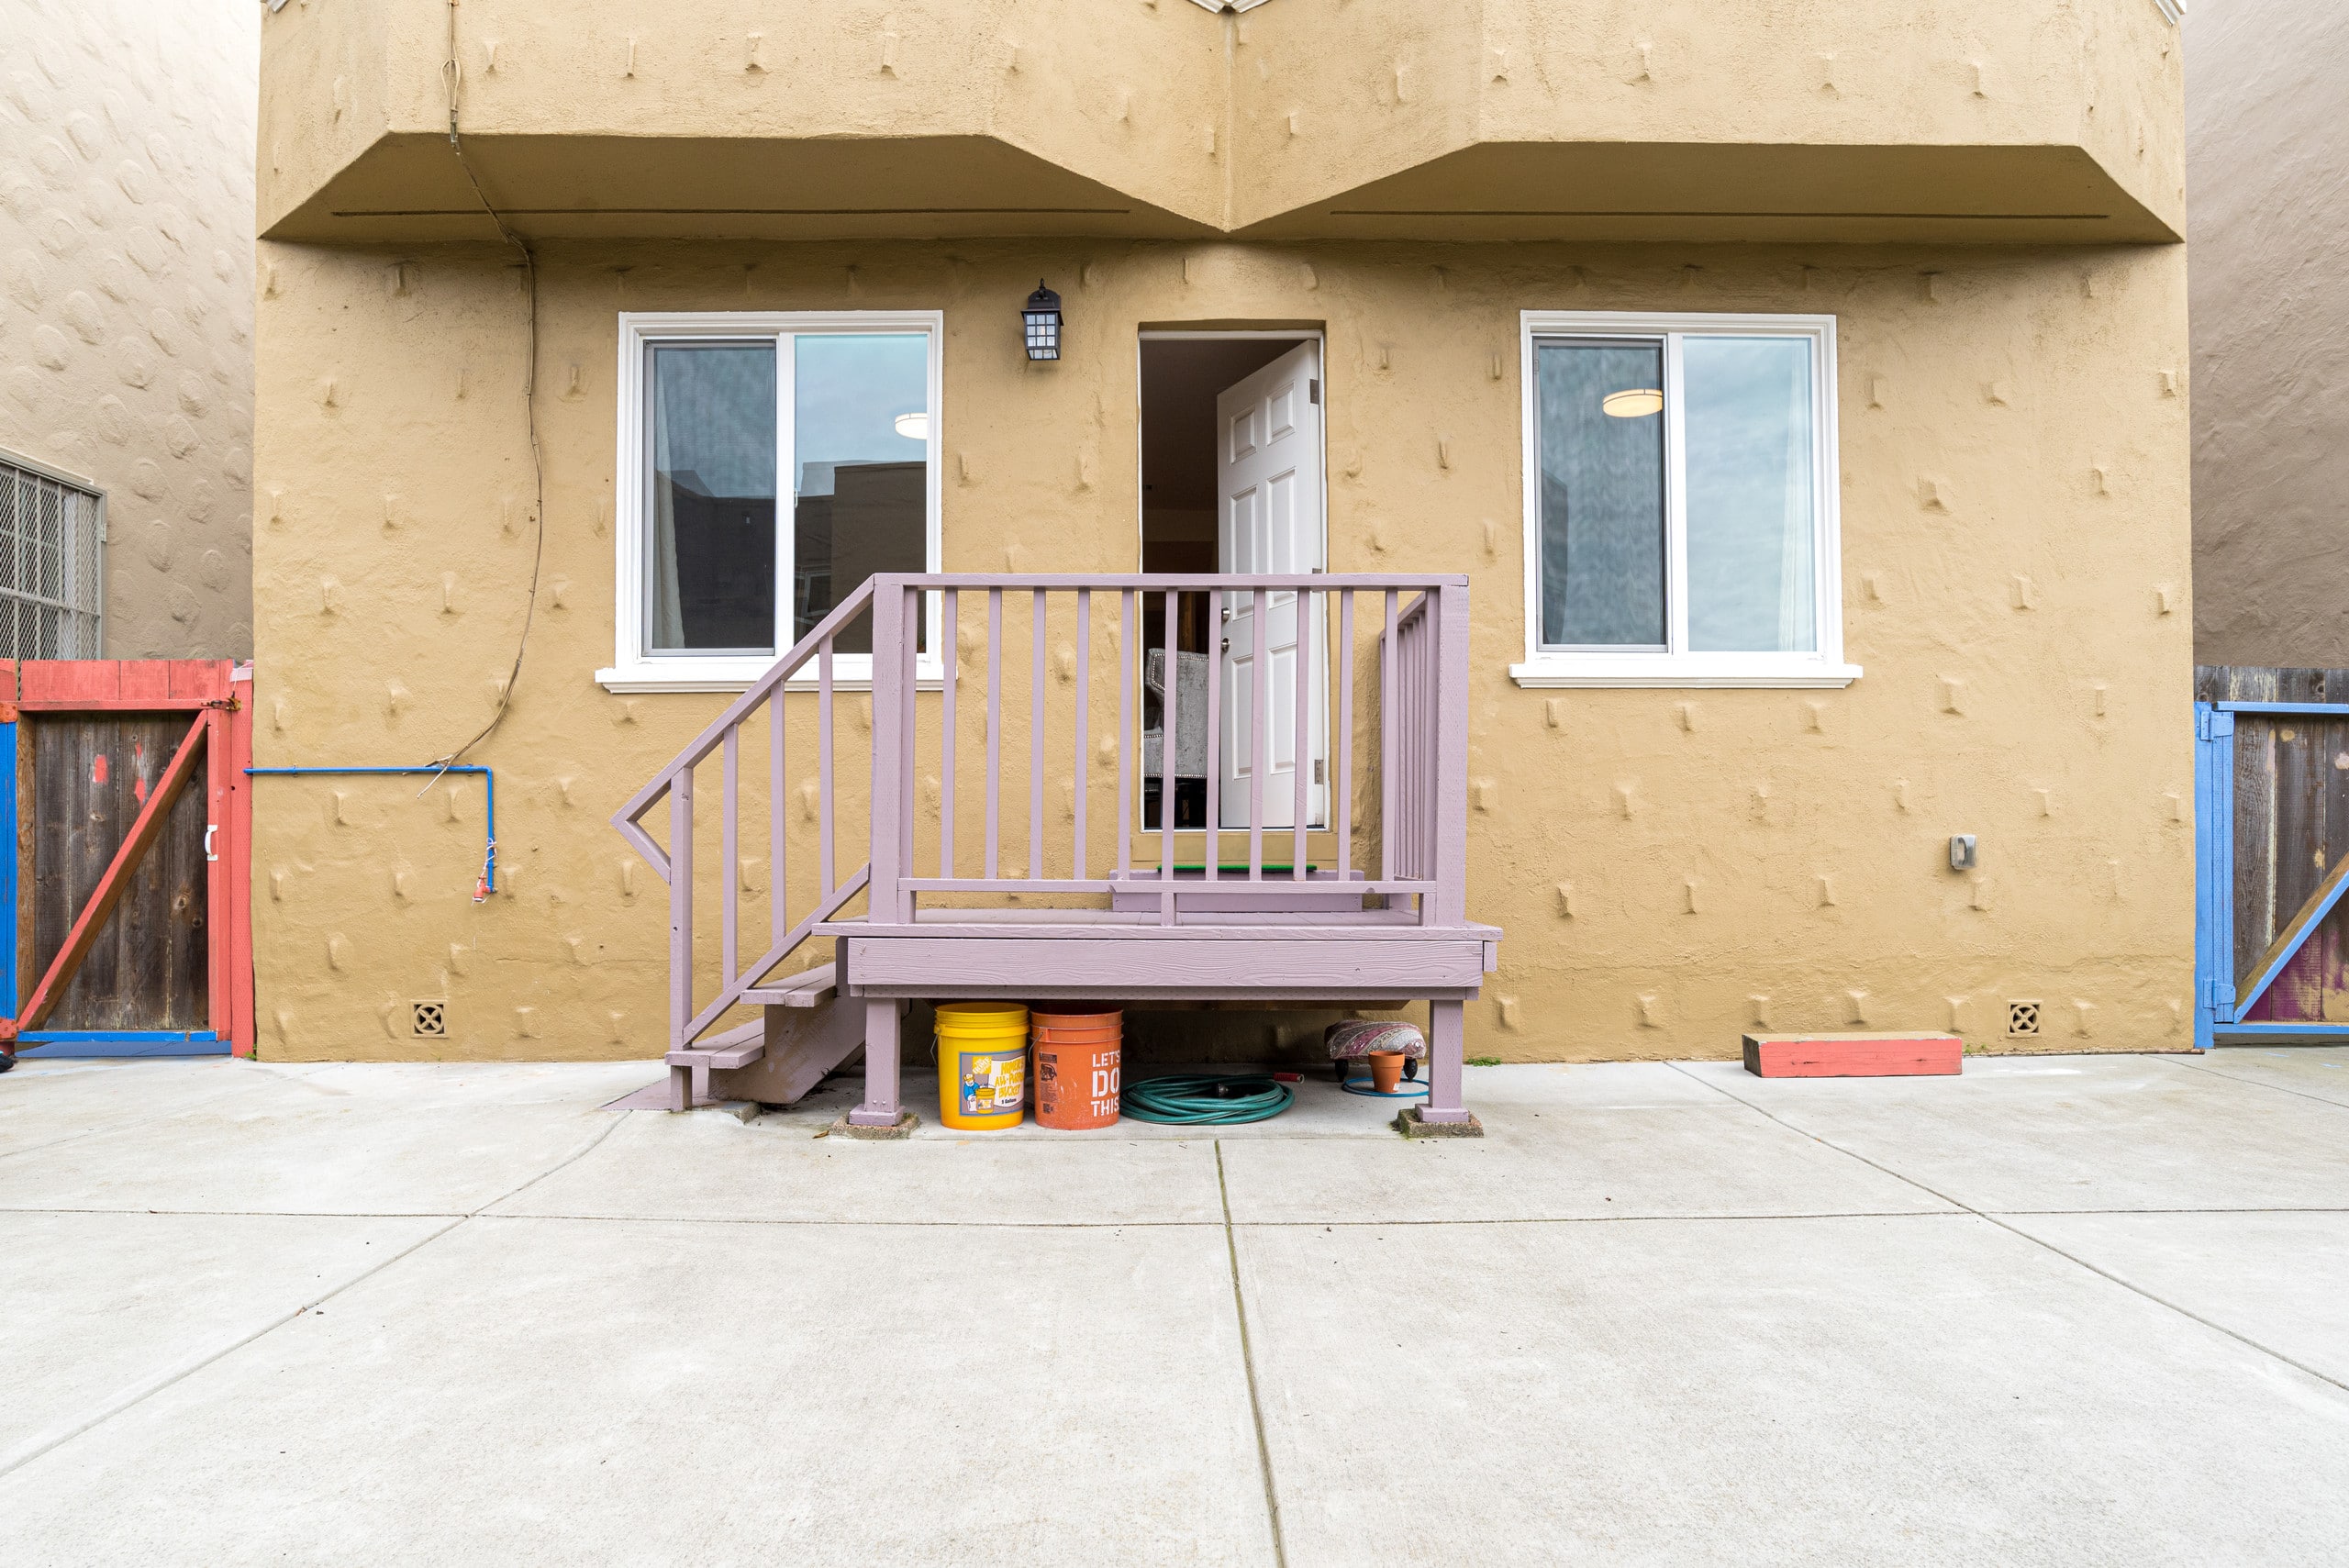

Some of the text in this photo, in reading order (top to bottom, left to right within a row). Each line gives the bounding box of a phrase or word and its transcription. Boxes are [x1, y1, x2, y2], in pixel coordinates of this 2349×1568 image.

[1092, 1051, 1119, 1067] LET'S
[1092, 1067, 1119, 1097] DO
[1091, 1097, 1119, 1117] THIS
